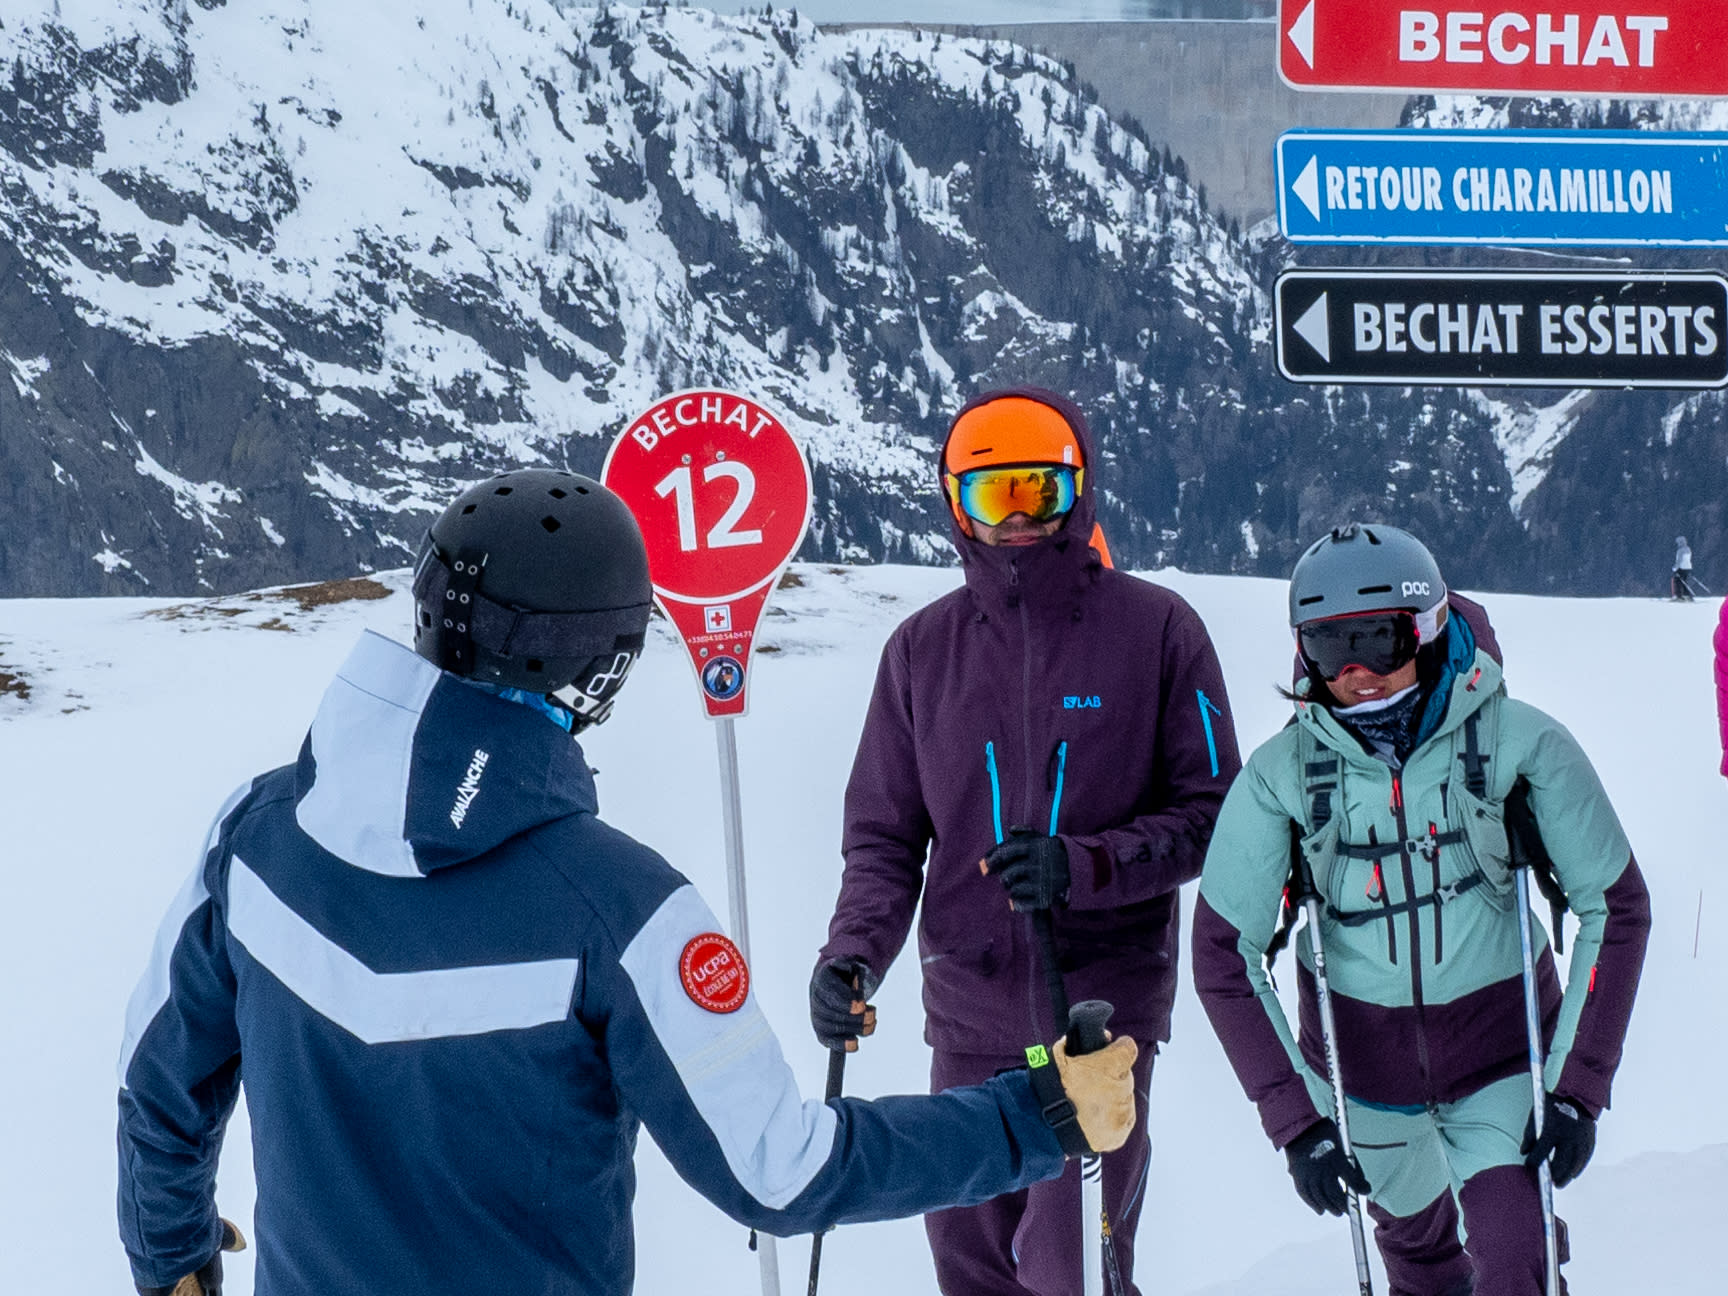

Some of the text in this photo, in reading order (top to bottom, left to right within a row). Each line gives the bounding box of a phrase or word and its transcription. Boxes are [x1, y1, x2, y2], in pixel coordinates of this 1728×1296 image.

[1399, 10, 1668, 67] BECHAT
[1326, 166, 1673, 215] RETOUR CHARAMILLON
[1353, 303, 1718, 357] BECHAT ESSERTS
[631, 397, 772, 452] BECHAT
[654, 460, 763, 552] 12
[450, 749, 489, 830] AVALANCHE
